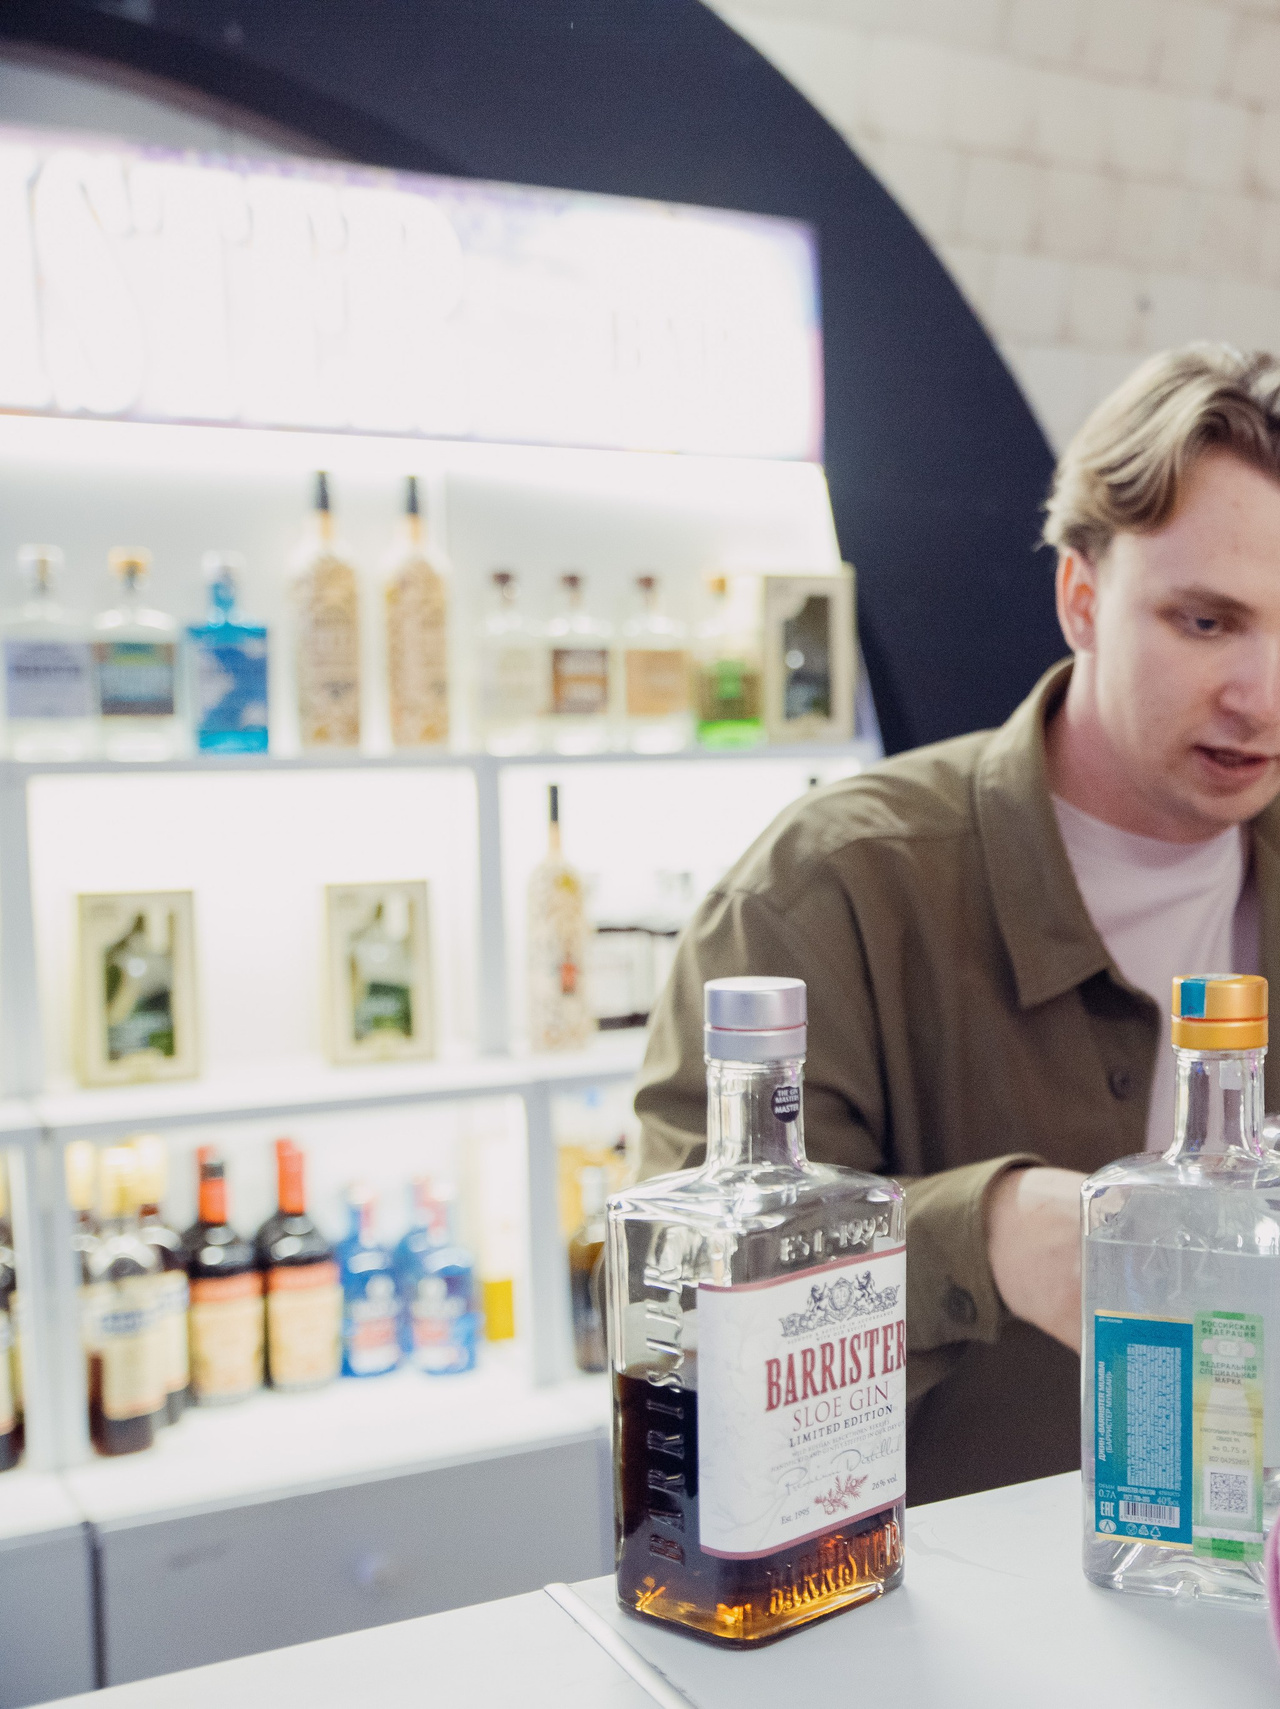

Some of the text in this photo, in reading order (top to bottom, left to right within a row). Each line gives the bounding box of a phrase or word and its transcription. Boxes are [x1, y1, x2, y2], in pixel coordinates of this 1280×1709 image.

[777, 1089, 788, 1097] THE
[765, 1319, 906, 1412] BARRISTER
[789, 1404, 893, 1448] LIMITED EDITION
[792, 1380, 889, 1432] SLOE GIN
[1098, 1437, 1106, 1462] ДЖИН
